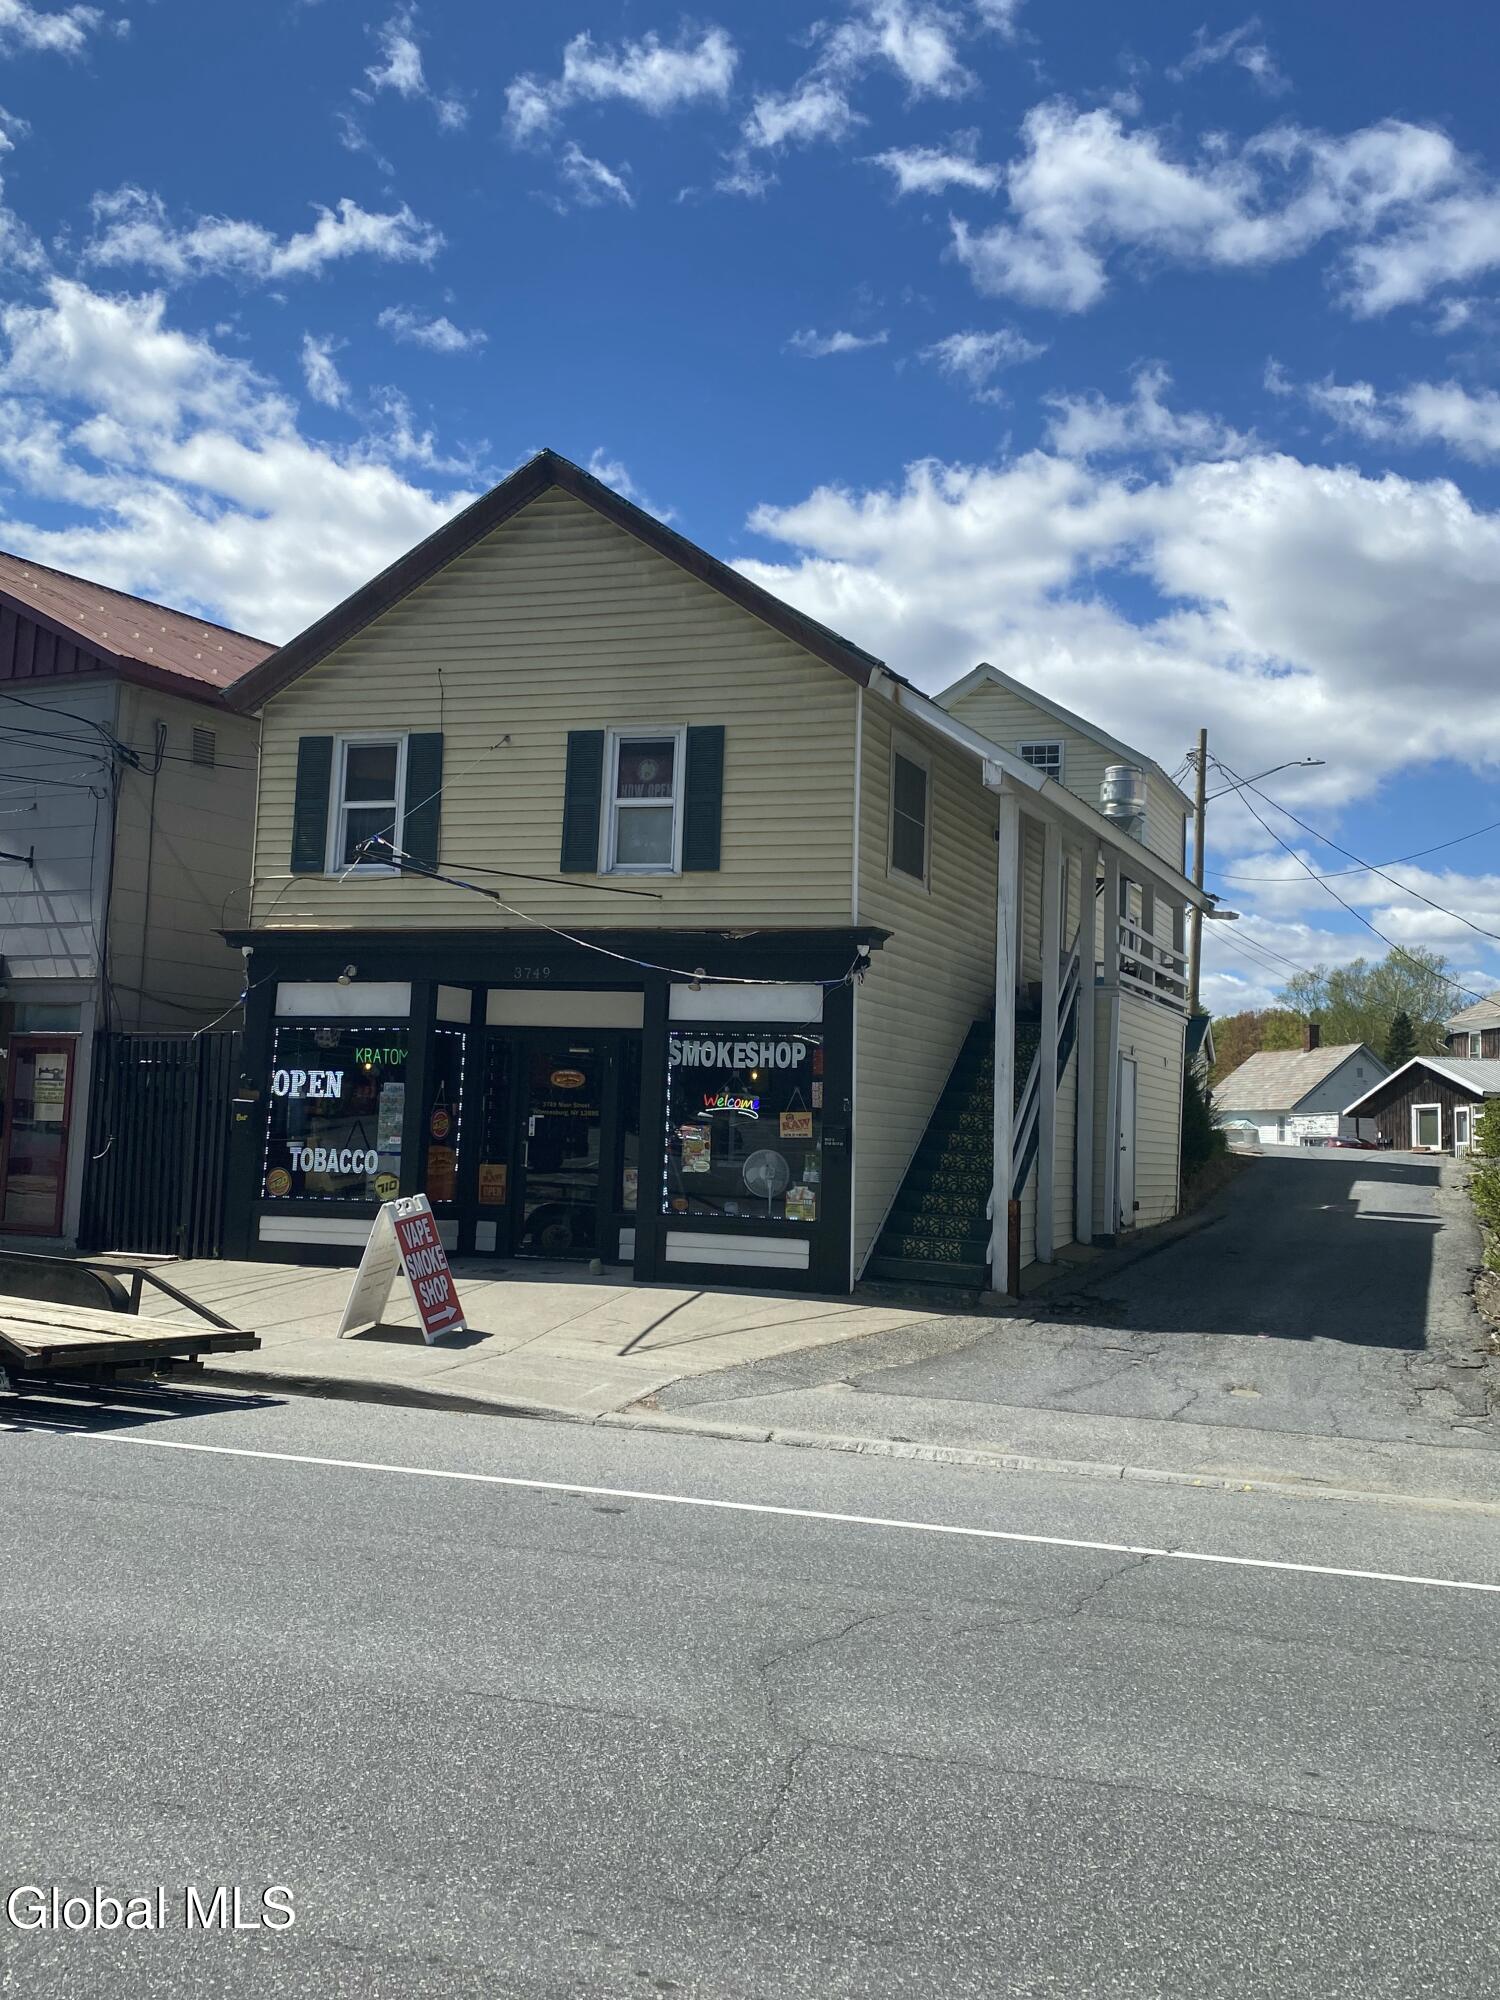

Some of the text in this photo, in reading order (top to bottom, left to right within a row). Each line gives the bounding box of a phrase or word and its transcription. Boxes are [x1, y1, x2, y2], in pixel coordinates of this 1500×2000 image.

[621, 783, 645, 797] NOW
[513, 966, 551, 979] 3749
[669, 1040, 807, 1069] SMOKESHOP
[272, 1069, 344, 1098] OPEN
[703, 1093, 760, 1111] Welcome
[782, 1118, 810, 1131] RAW
[289, 1146, 379, 1175] TOBACCO
[401, 1217, 433, 1249] VAPE
[405, 1244, 447, 1281] SMOKE
[418, 1274, 449, 1308] SHOP
